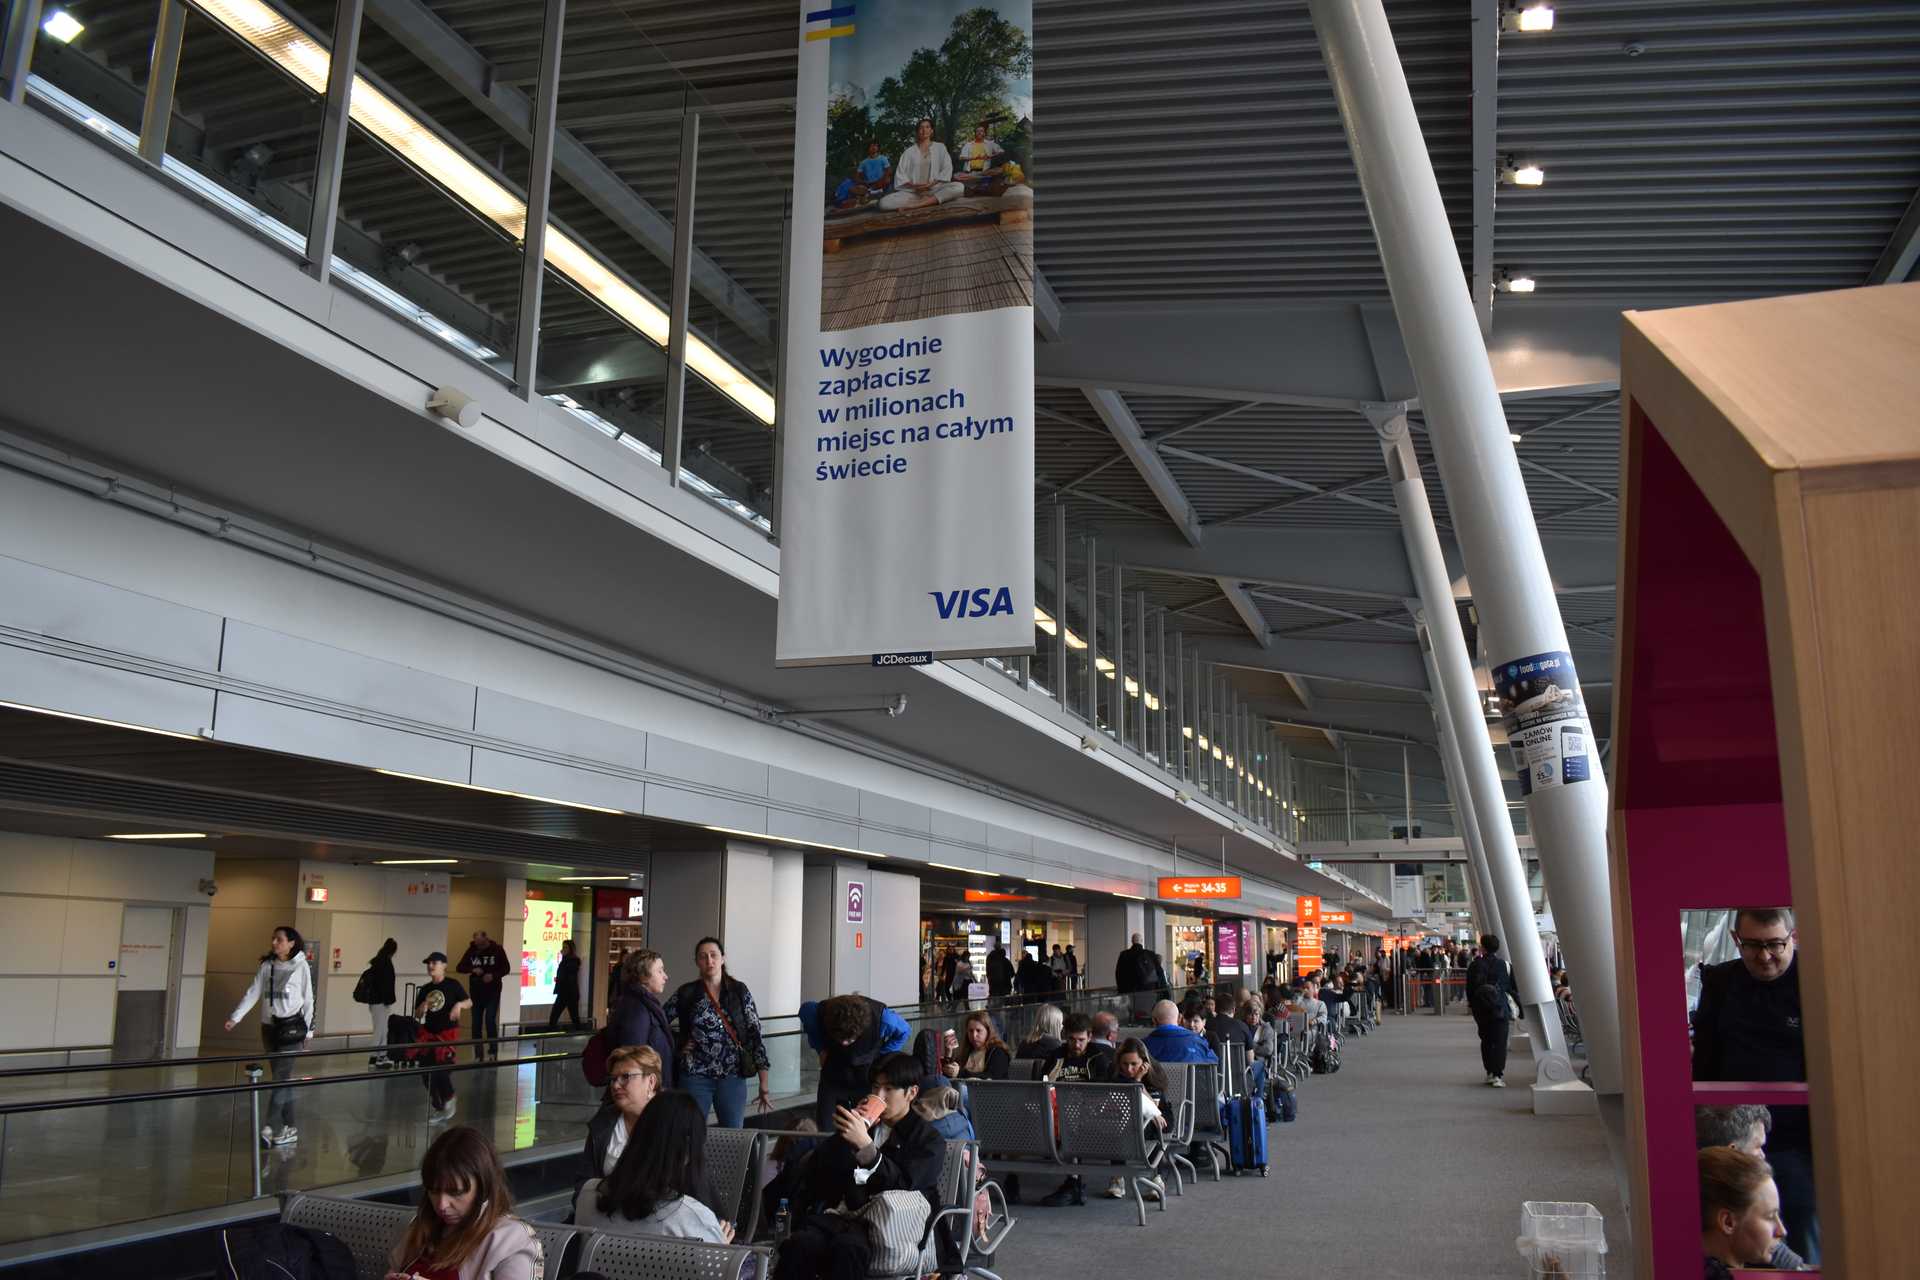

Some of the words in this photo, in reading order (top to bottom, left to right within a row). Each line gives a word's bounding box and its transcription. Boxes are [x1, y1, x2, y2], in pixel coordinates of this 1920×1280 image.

[819, 336, 942, 370] Wygodnie
[818, 367, 931, 397] zapłacisz
[818, 408, 839, 423] w
[845, 389, 965, 421] milionach
[817, 428, 895, 452] miejsc
[901, 425, 929, 443] na
[935, 415, 1014, 440] całym
[816, 454, 907, 480] świecie
[928, 587, 1014, 619] VISA
[877, 654, 927, 664] JCDecaux
[1523, 726, 1553, 739] ZAMÓW
[1526, 735, 1553, 746] ONLINE
[1201, 882, 1227, 893] 34-35
[544, 911, 569, 928] 2+1
[542, 931, 569, 941] GRATIS
